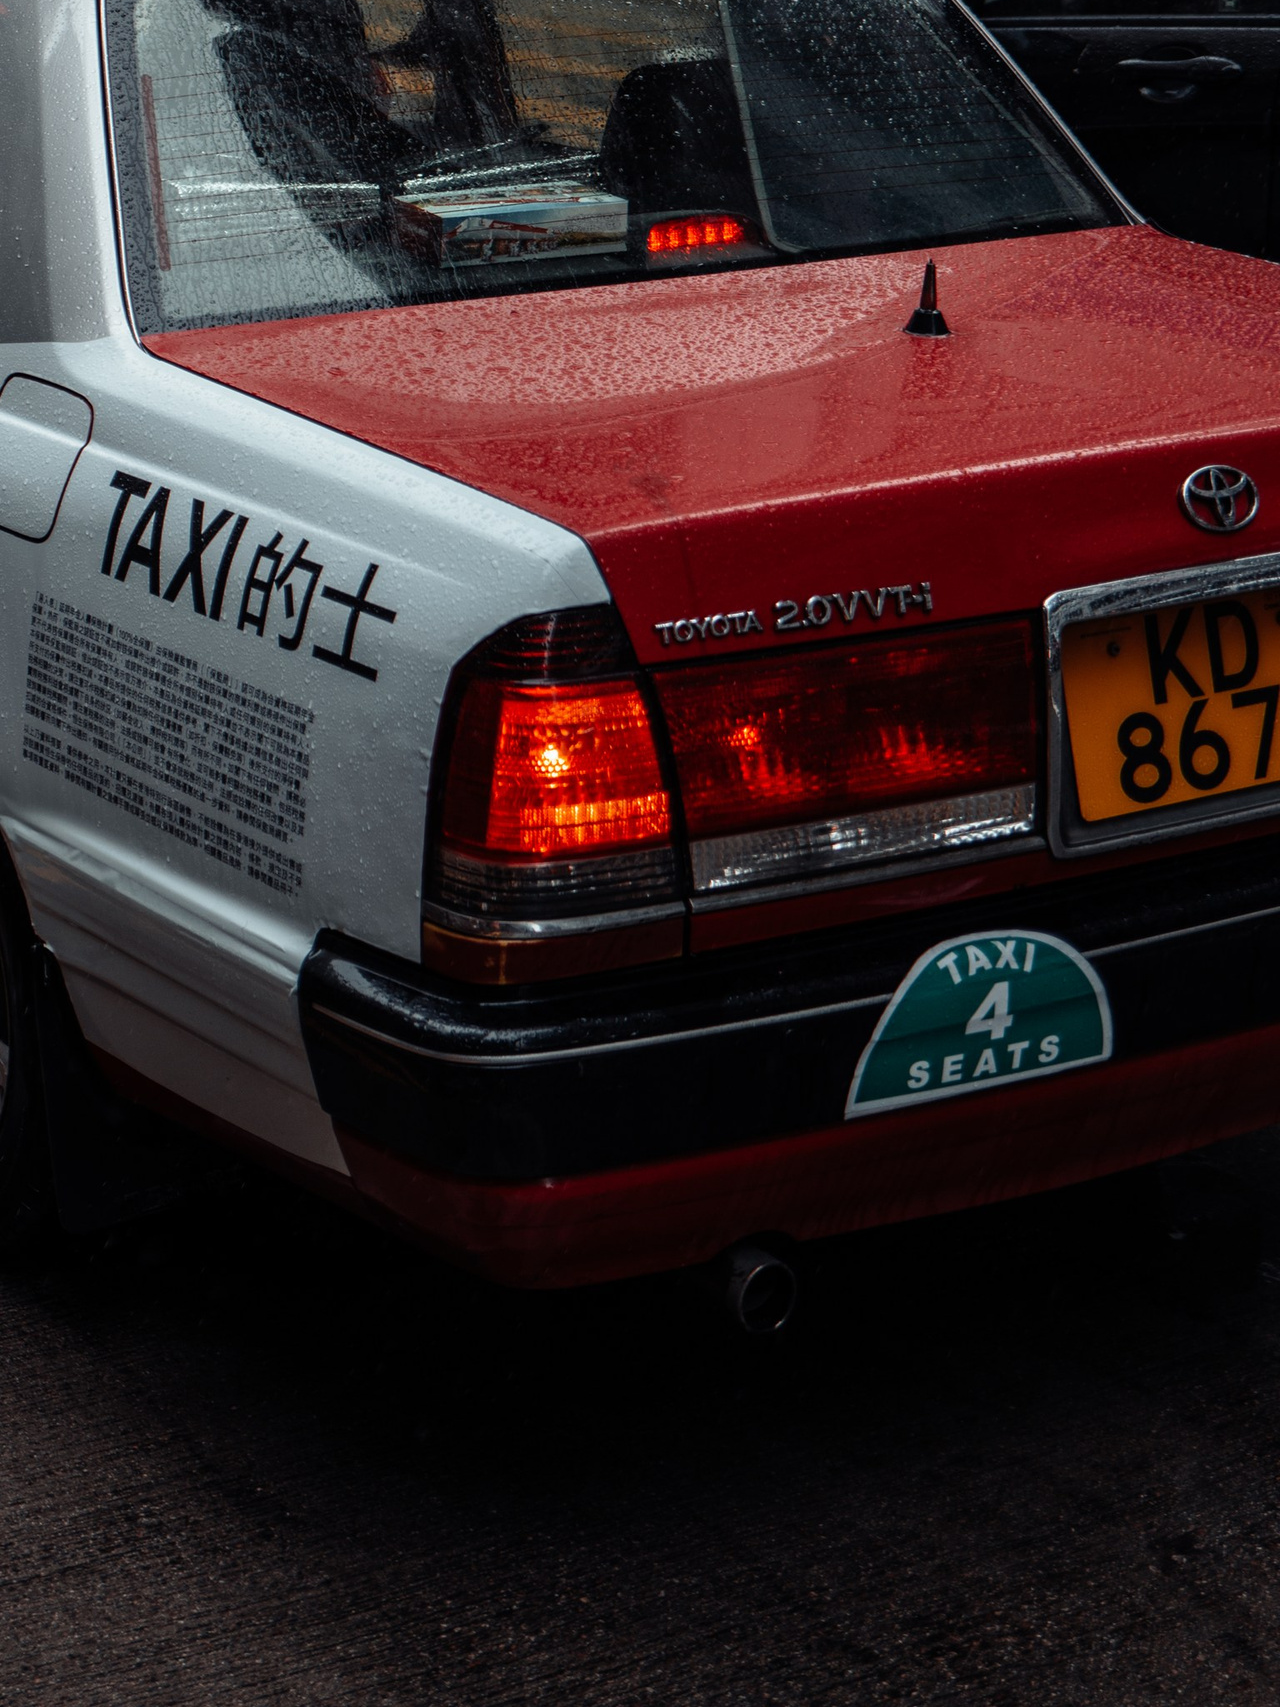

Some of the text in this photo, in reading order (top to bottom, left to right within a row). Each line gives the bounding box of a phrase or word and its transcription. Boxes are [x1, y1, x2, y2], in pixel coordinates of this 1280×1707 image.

[654, 610, 765, 647] TOYOTA
[1143, 599, 1261, 705] KD
[1116, 683, 1280, 805] 867
[936, 937, 1037, 986] TAXI
[964, 980, 1015, 1041] 4
[906, 1033, 1062, 1090] SEATS
